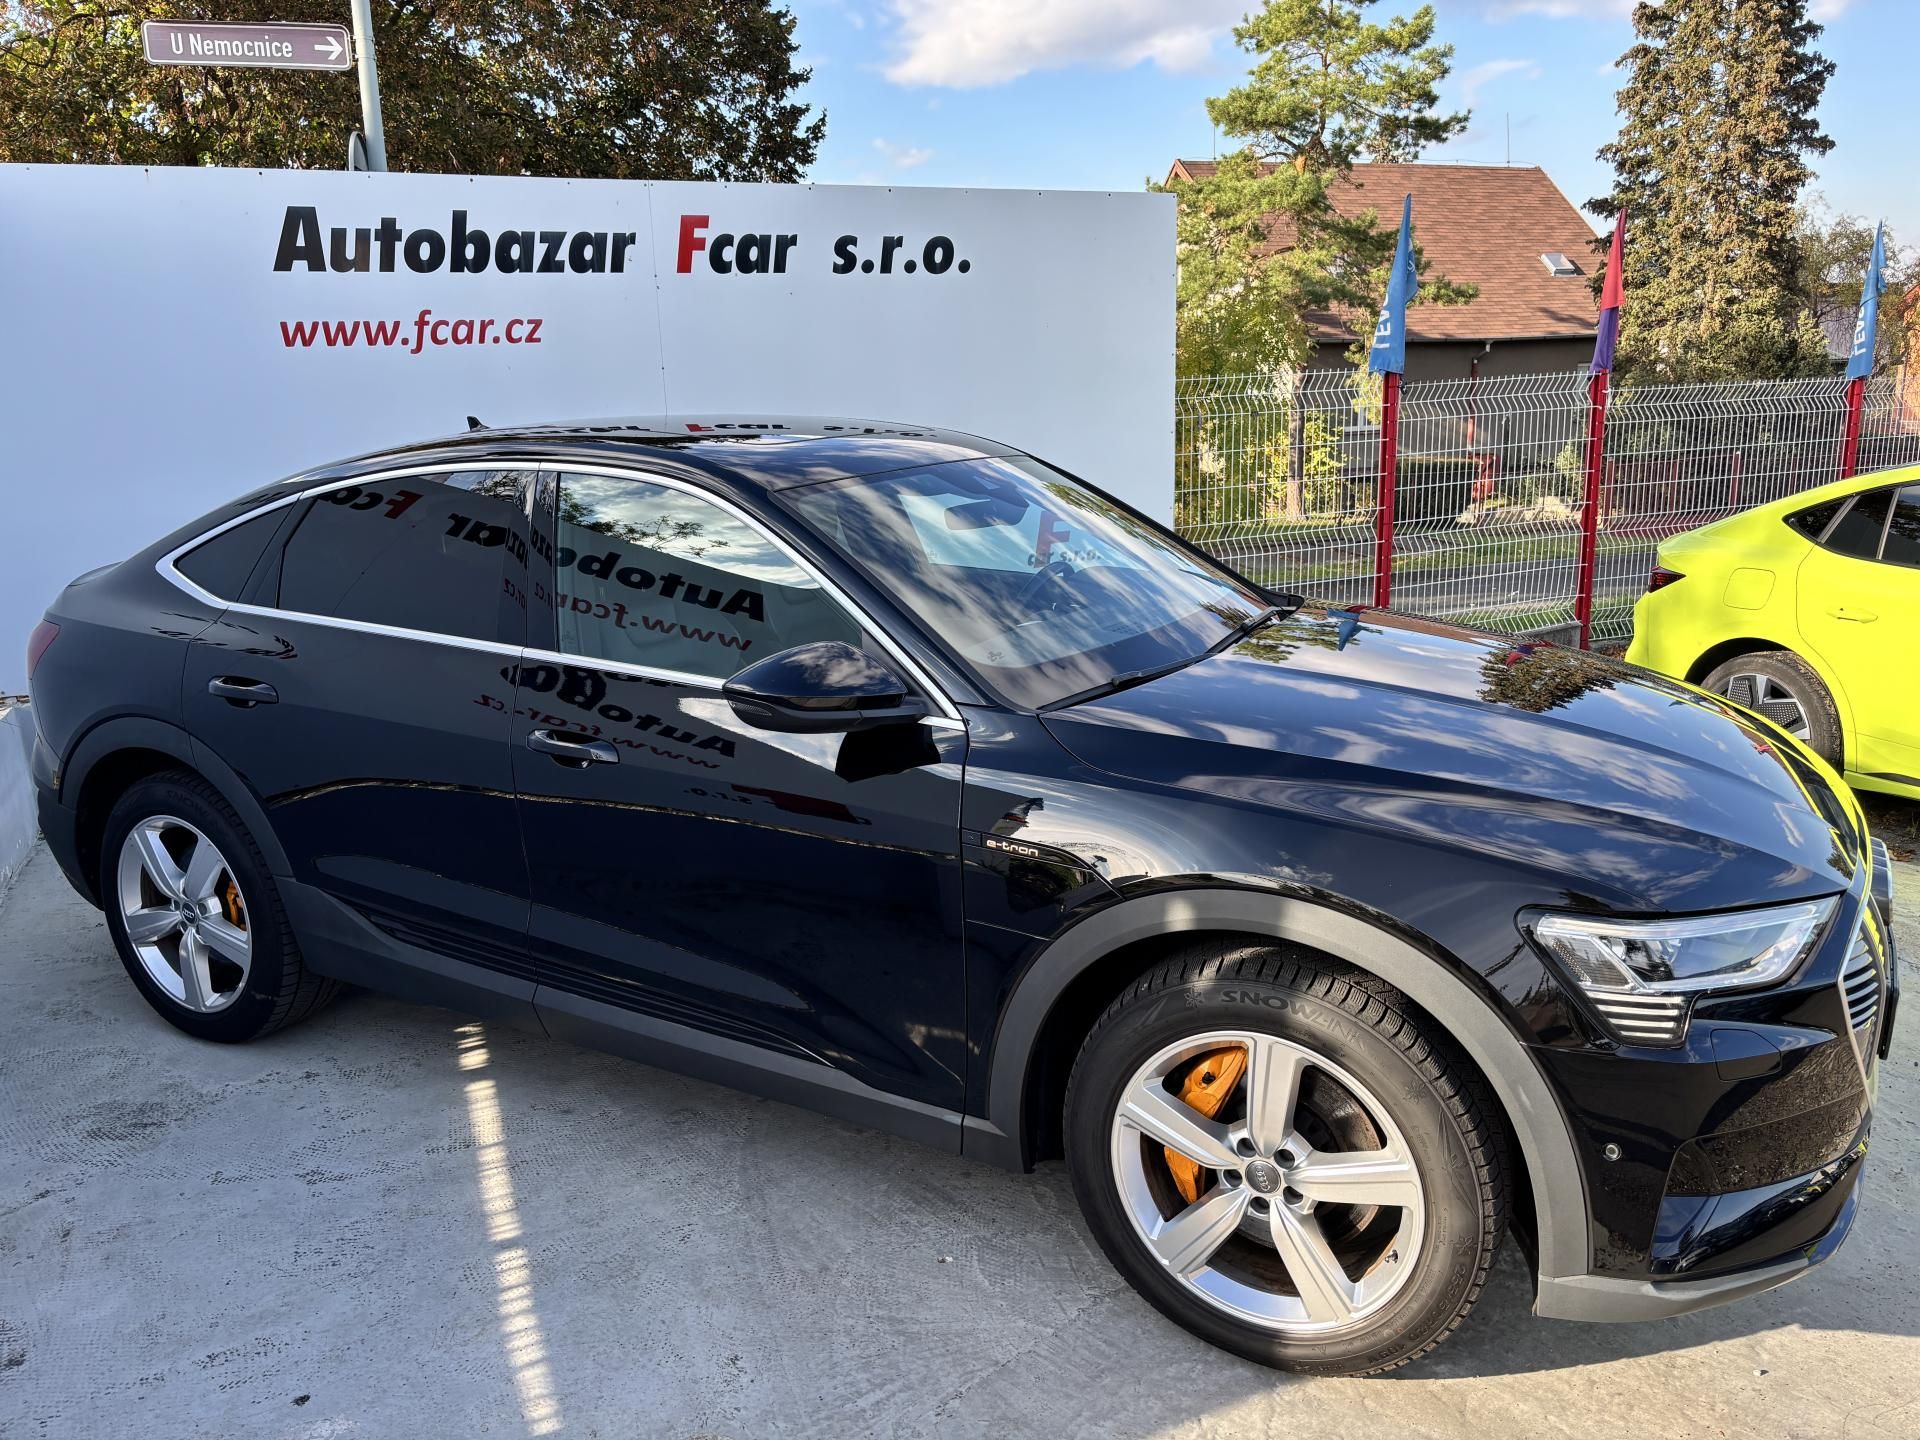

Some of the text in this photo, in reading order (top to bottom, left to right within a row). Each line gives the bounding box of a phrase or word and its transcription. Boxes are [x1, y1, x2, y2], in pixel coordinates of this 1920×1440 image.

[170, 33, 293, 58] U Nemocnice
[273, 206, 972, 275] Autobazar Fcar s.r.o.
[280, 309, 543, 354] www.fcar.cz
[986, 839, 1039, 857] e-tron
